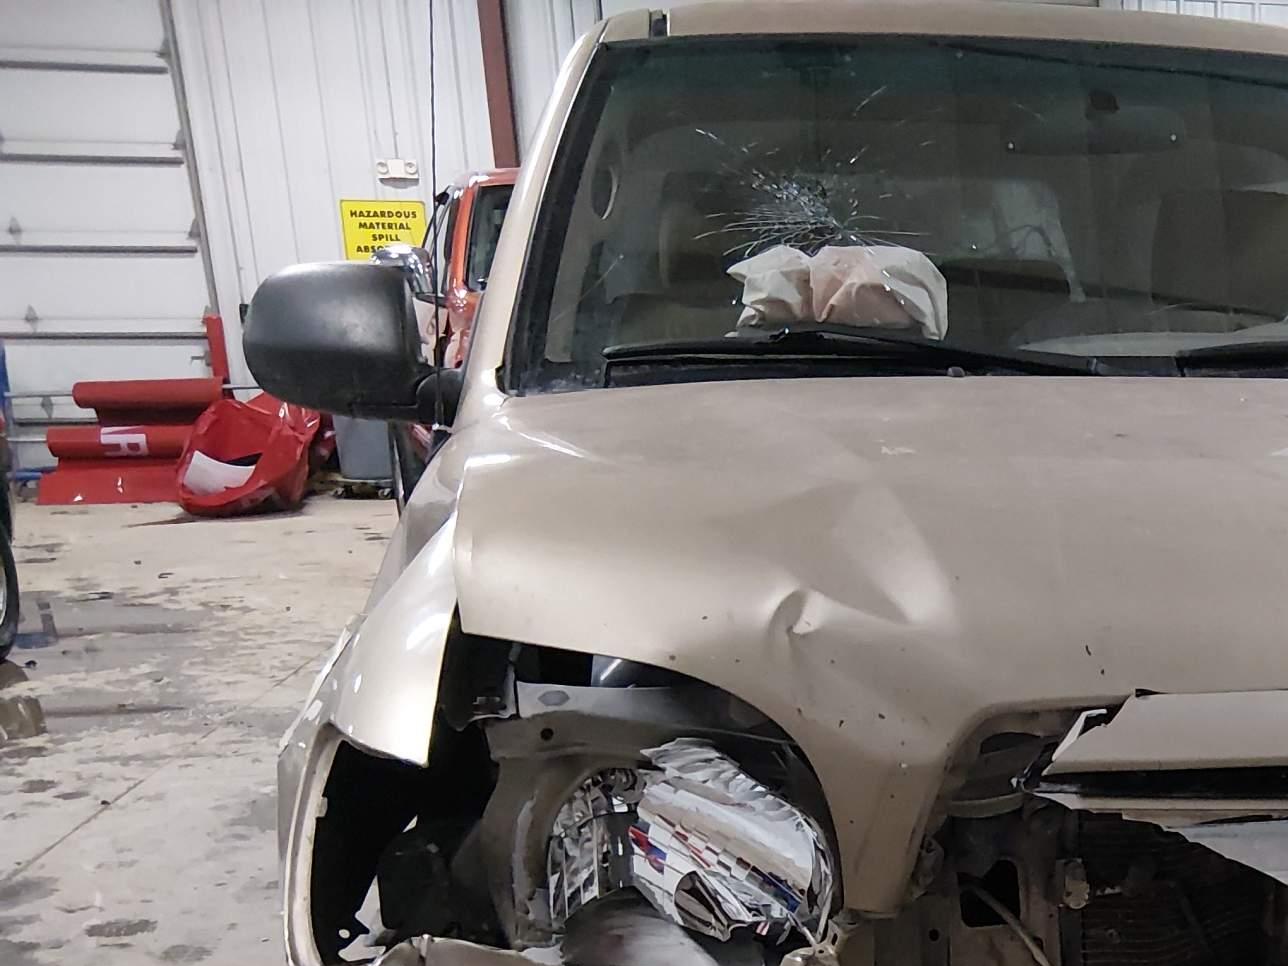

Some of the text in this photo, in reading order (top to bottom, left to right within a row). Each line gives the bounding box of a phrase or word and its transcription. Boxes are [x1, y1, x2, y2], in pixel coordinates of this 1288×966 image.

[350, 210, 417, 219] HAZARDOUS
[358, 222, 412, 231] MATERIAL
[371, 234, 401, 242] SPILL
